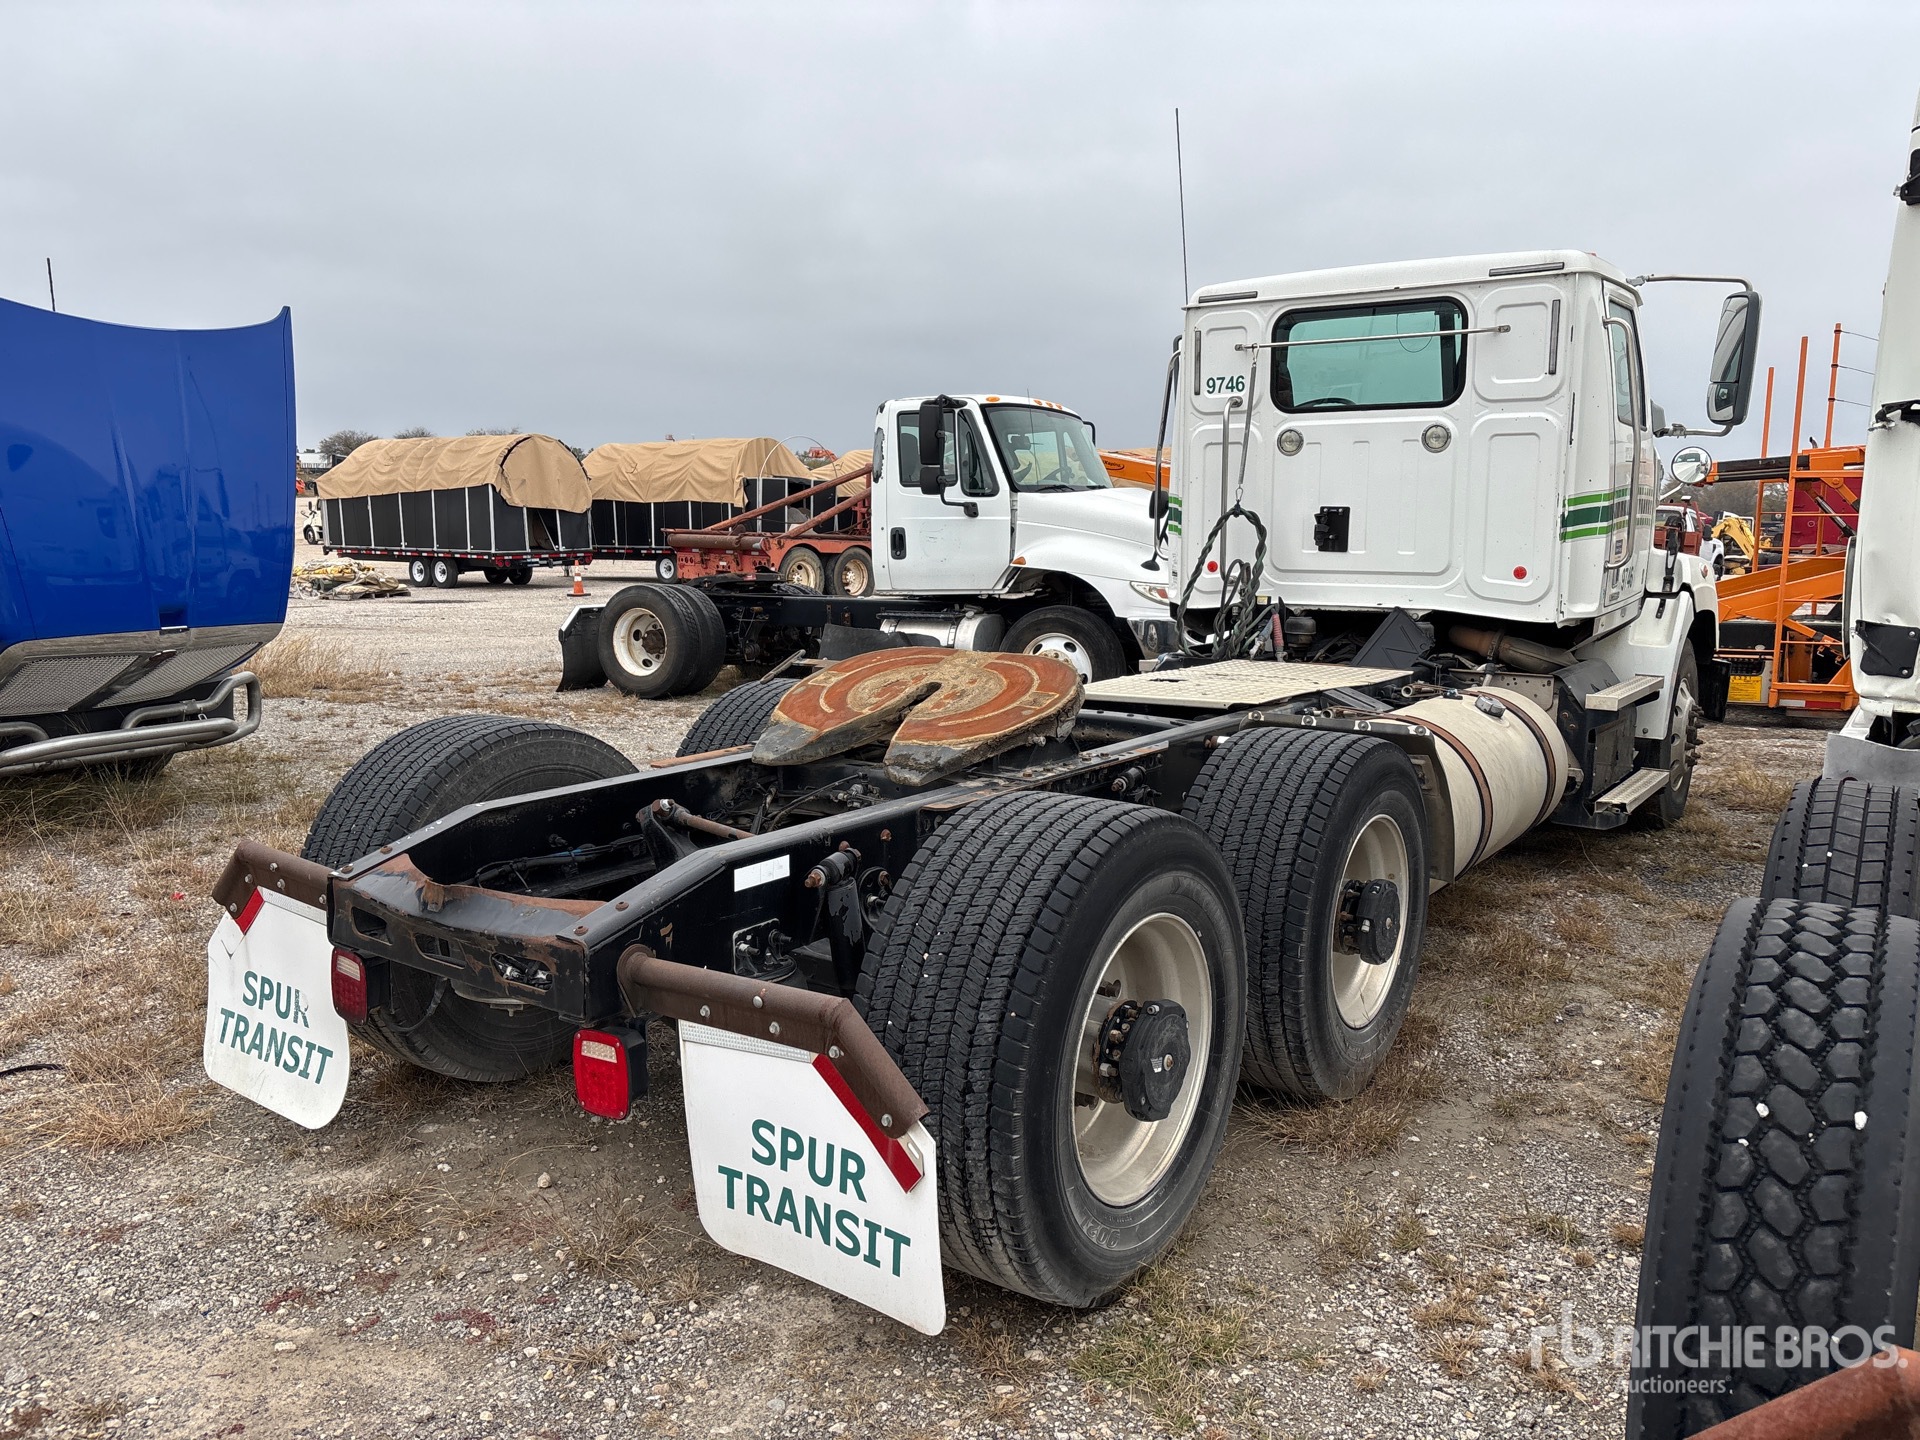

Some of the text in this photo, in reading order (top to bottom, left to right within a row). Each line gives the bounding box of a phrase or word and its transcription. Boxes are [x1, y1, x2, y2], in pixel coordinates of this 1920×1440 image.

[1206, 375, 1245, 394] 9746
[242, 970, 310, 1029] SPUR
[219, 1007, 334, 1085] TRANSIT
[751, 1118, 868, 1204] SPUR
[717, 1164, 912, 1278] TRANSIT
